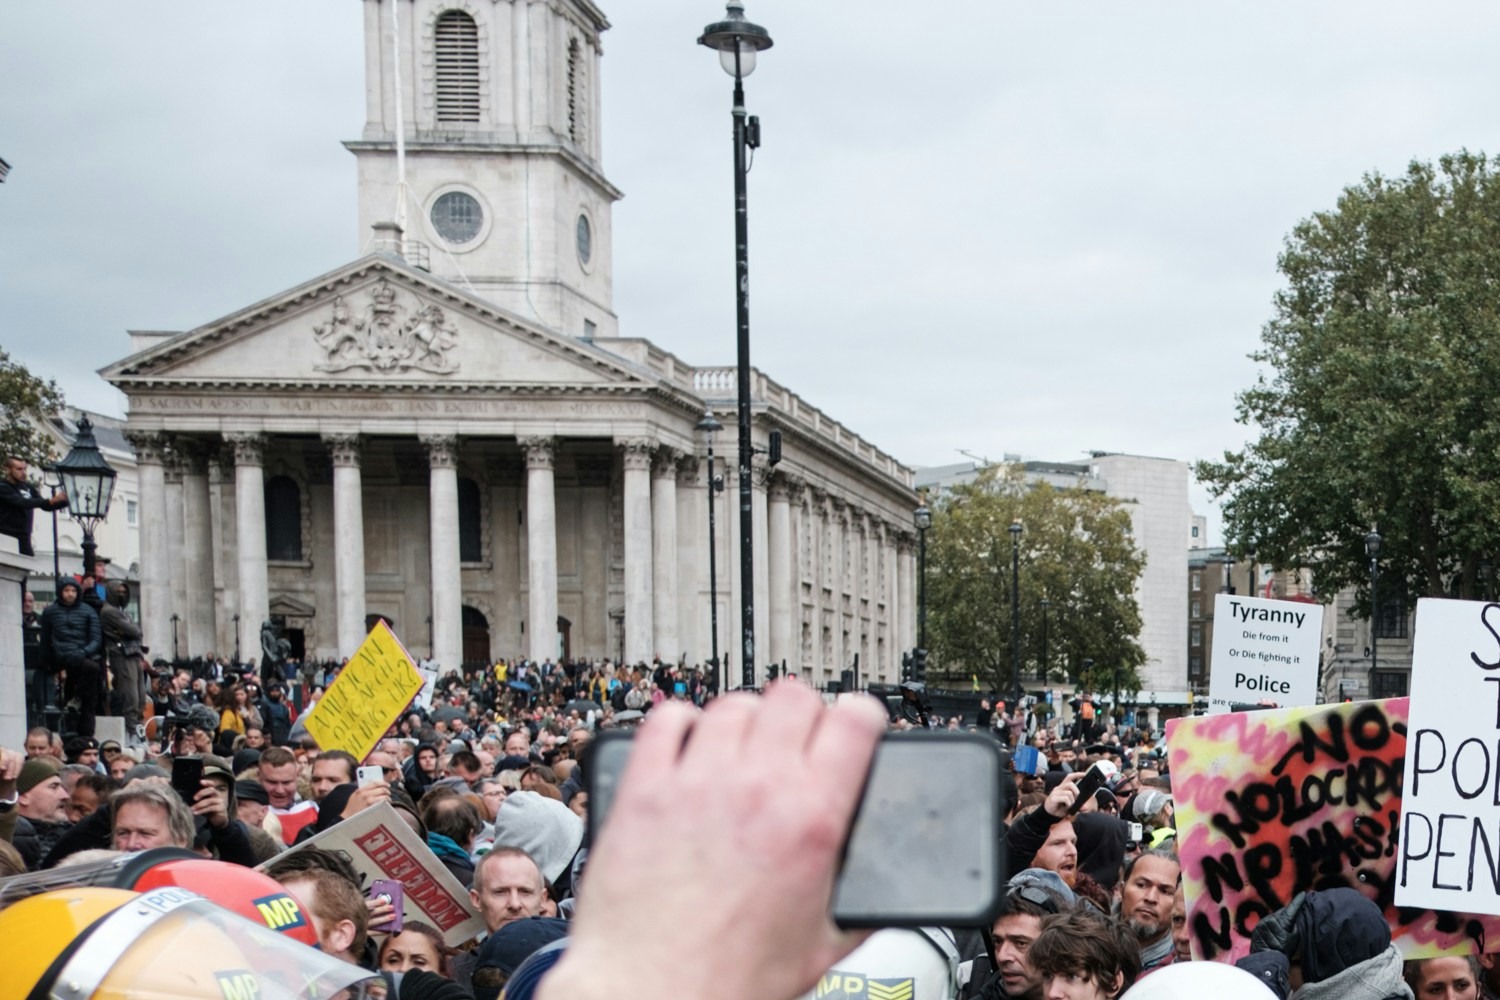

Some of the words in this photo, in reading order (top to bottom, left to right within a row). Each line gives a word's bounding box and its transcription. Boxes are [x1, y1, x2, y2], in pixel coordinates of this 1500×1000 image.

[1230, 602, 1306, 628] Tyranny
[1242, 630, 1257, 639] Die
[1259, 632, 1280, 642] from
[1282, 634, 1289, 643] it
[1229, 648, 1240, 657] Or
[1242, 650, 1256, 659] Die
[1258, 651, 1292, 665] fighting
[1293, 655, 1300, 664] it
[1235, 673, 1291, 694] Police
[1212, 698, 1226, 706] are
[357, 826, 470, 931] FREEDOM
[256, 897, 300, 930] MP
[817, 973, 865, 999] MP
